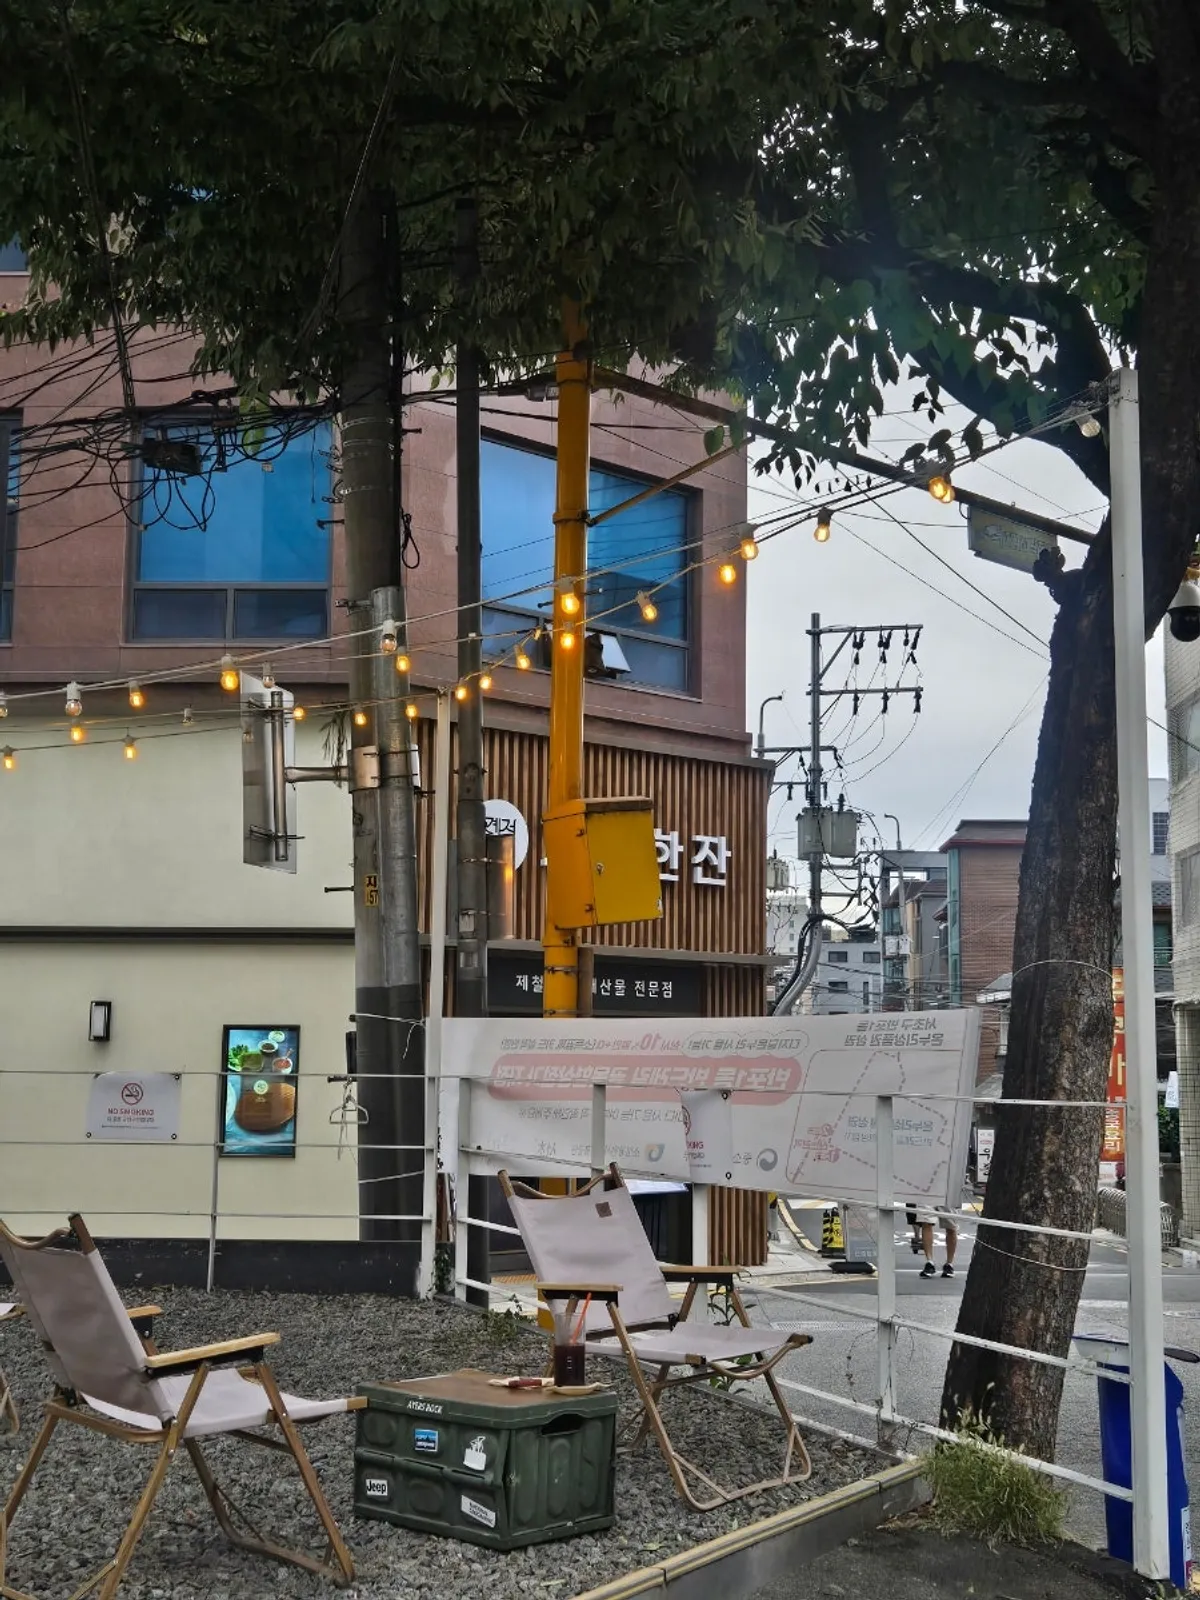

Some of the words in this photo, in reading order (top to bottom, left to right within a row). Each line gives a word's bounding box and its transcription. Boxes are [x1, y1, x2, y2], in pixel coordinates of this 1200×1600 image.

[633, 980, 673, 999] 전문점
[108, 1107, 119, 1115] NO
[119, 1107, 155, 1116] SMOKING
[366, 1479, 387, 1495] Jeep
